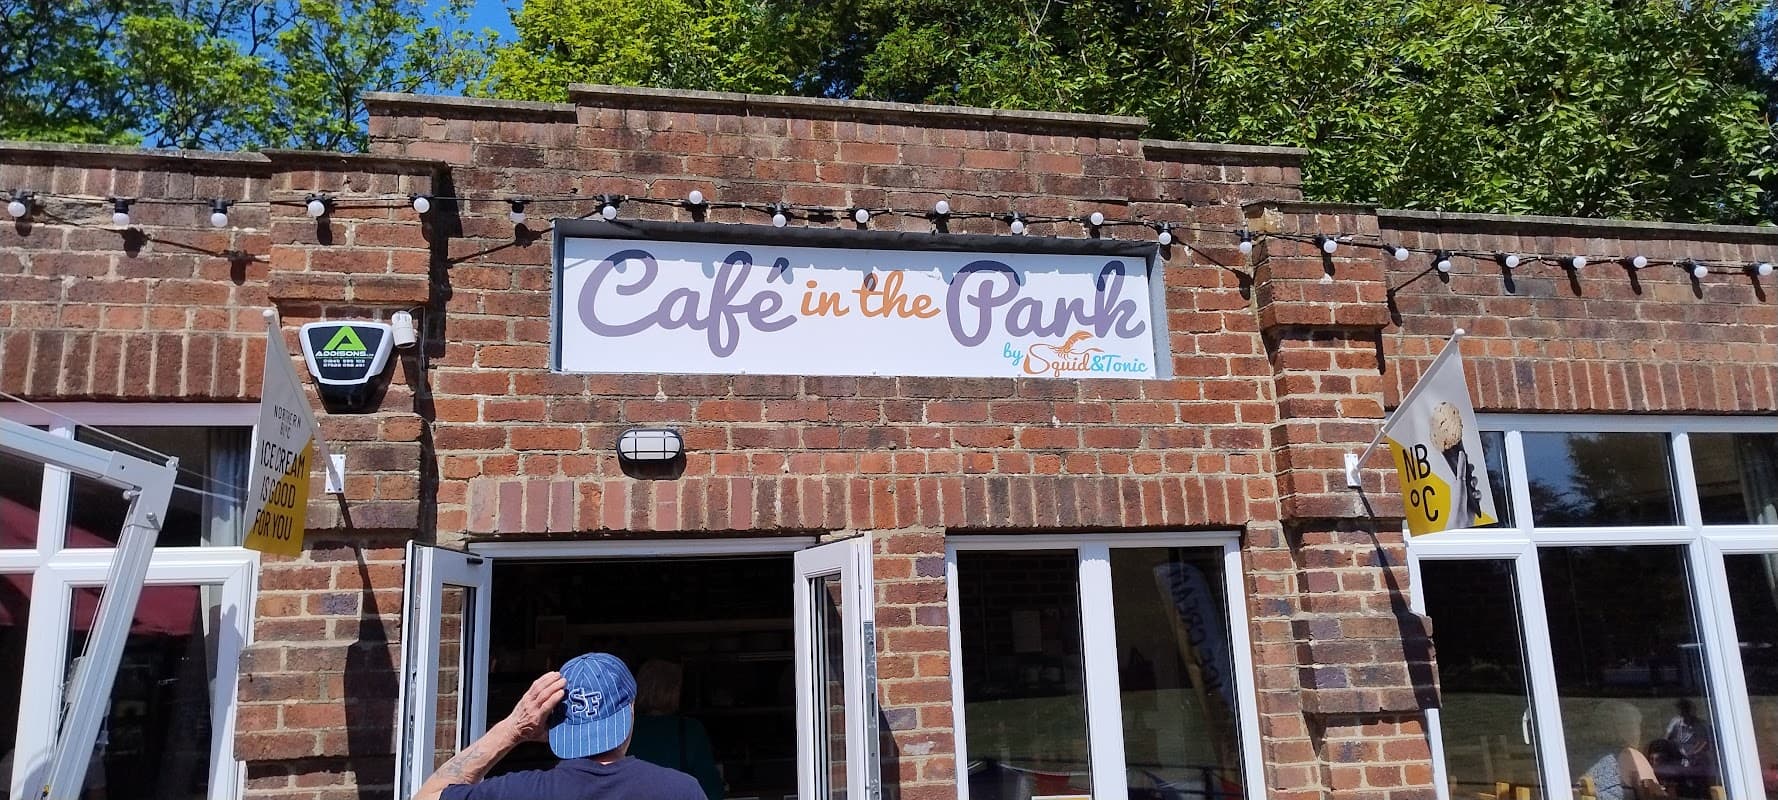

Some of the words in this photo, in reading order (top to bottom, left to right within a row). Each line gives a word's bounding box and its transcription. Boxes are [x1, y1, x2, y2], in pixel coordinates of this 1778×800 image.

[577, 248, 797, 358] Café
[800, 279, 850, 318] in
[852, 269, 942, 319] the
[945, 259, 1146, 348] Park
[1003, 342, 1023, 366] by
[260, 441, 276, 468] ICE
[274, 445, 306, 480] CREAM
[1402, 443, 1431, 483] NB
[260, 477, 270, 503] IS
[268, 480, 296, 509] GOOD
[252, 508, 274, 536] FOR
[273, 515, 293, 541] YOU
[569, 687, 602, 717] SF
